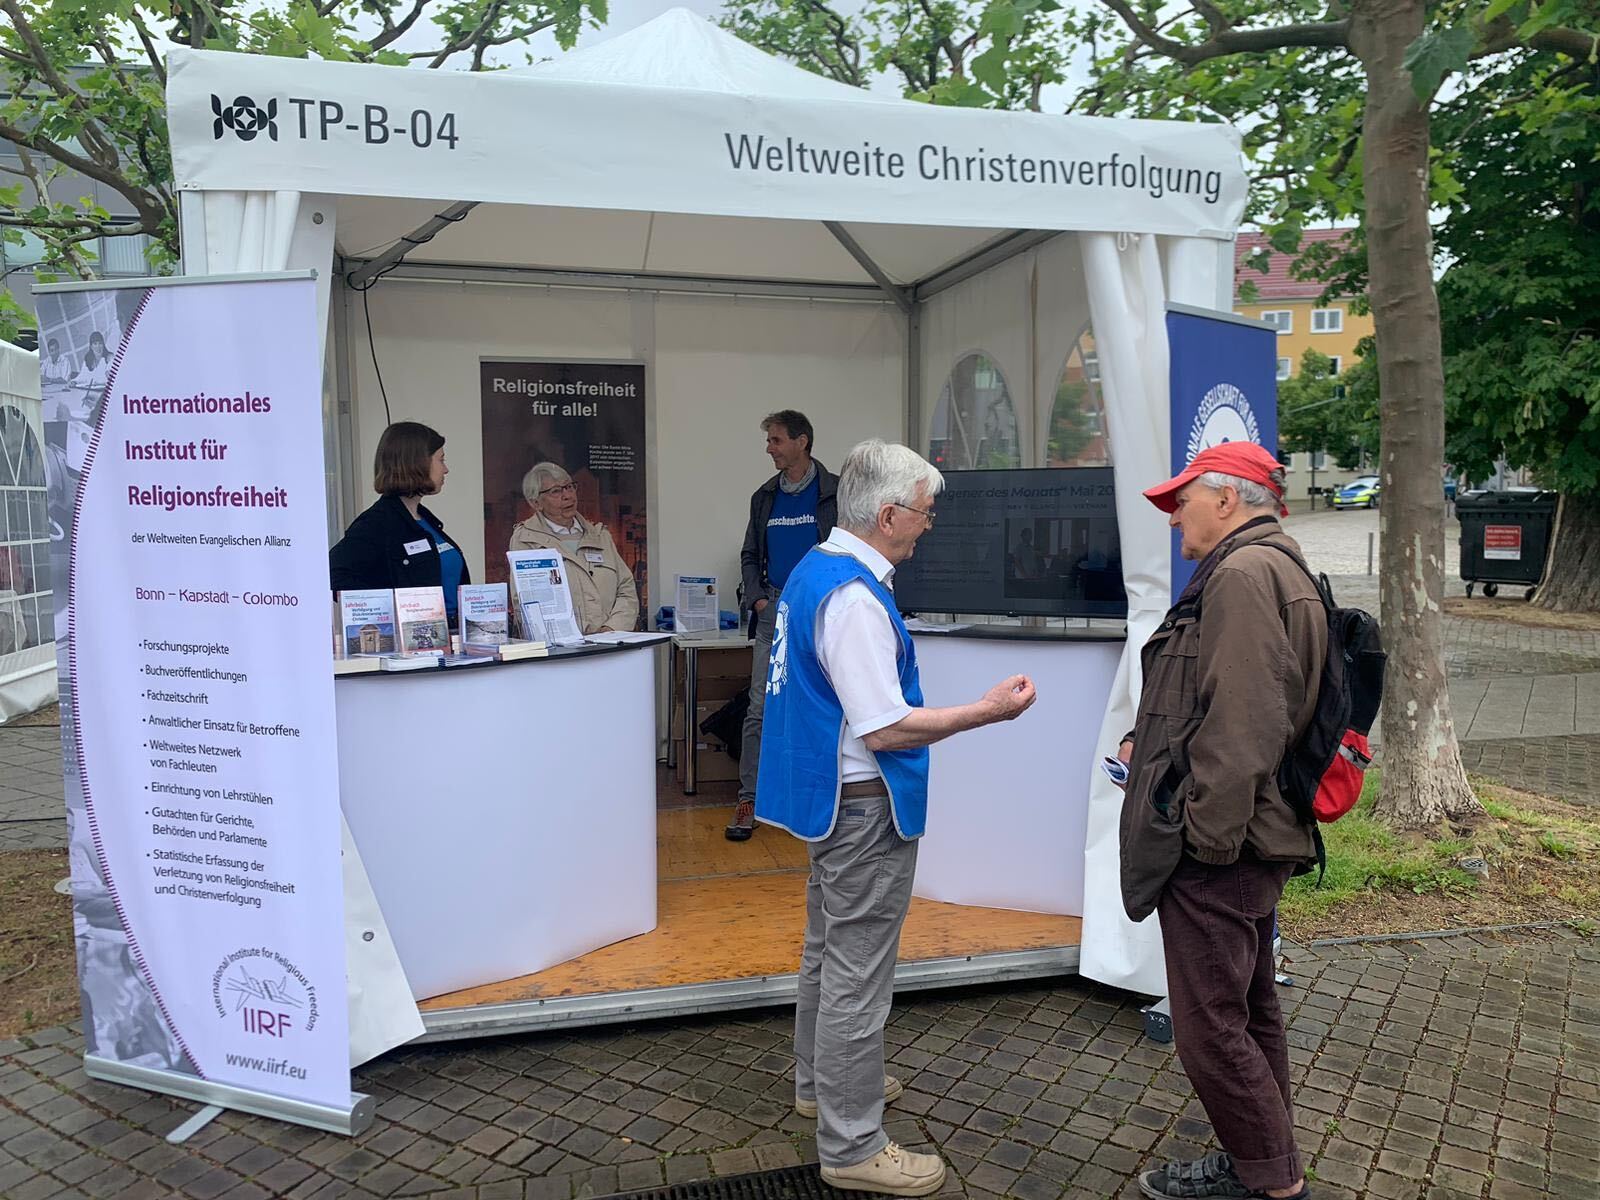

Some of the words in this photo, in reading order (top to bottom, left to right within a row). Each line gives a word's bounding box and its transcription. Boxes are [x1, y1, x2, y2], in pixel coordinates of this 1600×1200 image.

[288, 98, 459, 150] TP-B-04
[724, 132, 904, 180] Weltweite
[918, 144, 1222, 204] Christenverfolgung
[493, 378, 636, 397] Religionsfreiheit
[123, 392, 271, 414] Internationales
[532, 400, 558, 416] für
[562, 402, 598, 417] alle!
[126, 440, 196, 461] Institut
[202, 439, 227, 460] für
[128, 486, 288, 511] Religionsfreiheit
[132, 533, 145, 543] der
[147, 533, 197, 545] Weltweiten
[200, 534, 261, 547] Evangelischen
[265, 536, 291, 547] Allianz
[136, 587, 165, 601] Bonn
[179, 588, 229, 604] Kapstadt
[242, 592, 298, 607] Colombo
[143, 640, 229, 656] Forschungsprojekte
[145, 665, 247, 683] Buchveröffentlichungen
[147, 690, 208, 705] Fachzeitschrift
[148, 715, 201, 730] Anwaltlicher
[204, 720, 234, 733] Einsatz
[236, 722, 247, 733] für
[250, 724, 300, 738] Betroffene
[150, 740, 196, 754] Weltweites
[198, 744, 241, 758] Netzwerk
[151, 759, 167, 768] von
[169, 759, 217, 773] Fachleuten
[151, 782, 201, 799] Einrichtung
[204, 788, 221, 798] von
[223, 789, 273, 805] Lehrstühlen
[152, 807, 198, 823] Gutachten
[201, 811, 213, 823] für
[216, 812, 255, 829] Gerichte,
[152, 824, 196, 839] Behörden
[199, 830, 216, 841] und
[219, 830, 267, 847] Parlamente
[153, 849, 203, 865] Statistische
[205, 855, 248, 872] Erfassung
[250, 861, 264, 872] der
[154, 867, 203, 884] Verletzung
[205, 873, 222, 884] von
[224, 873, 295, 894] Religionsfreiheit
[155, 884, 176, 894] und
[178, 885, 261, 908] Christenverfolgung
[212, 958, 229, 1018] International
[228, 947, 260, 960] Institute
[261, 947, 273, 959] for
[274, 952, 308, 986] Religious
[306, 986, 320, 1032] Freedom
[243, 1008, 292, 1039] IIRF
[226, 1053, 306, 1080] www.iirf.eu
